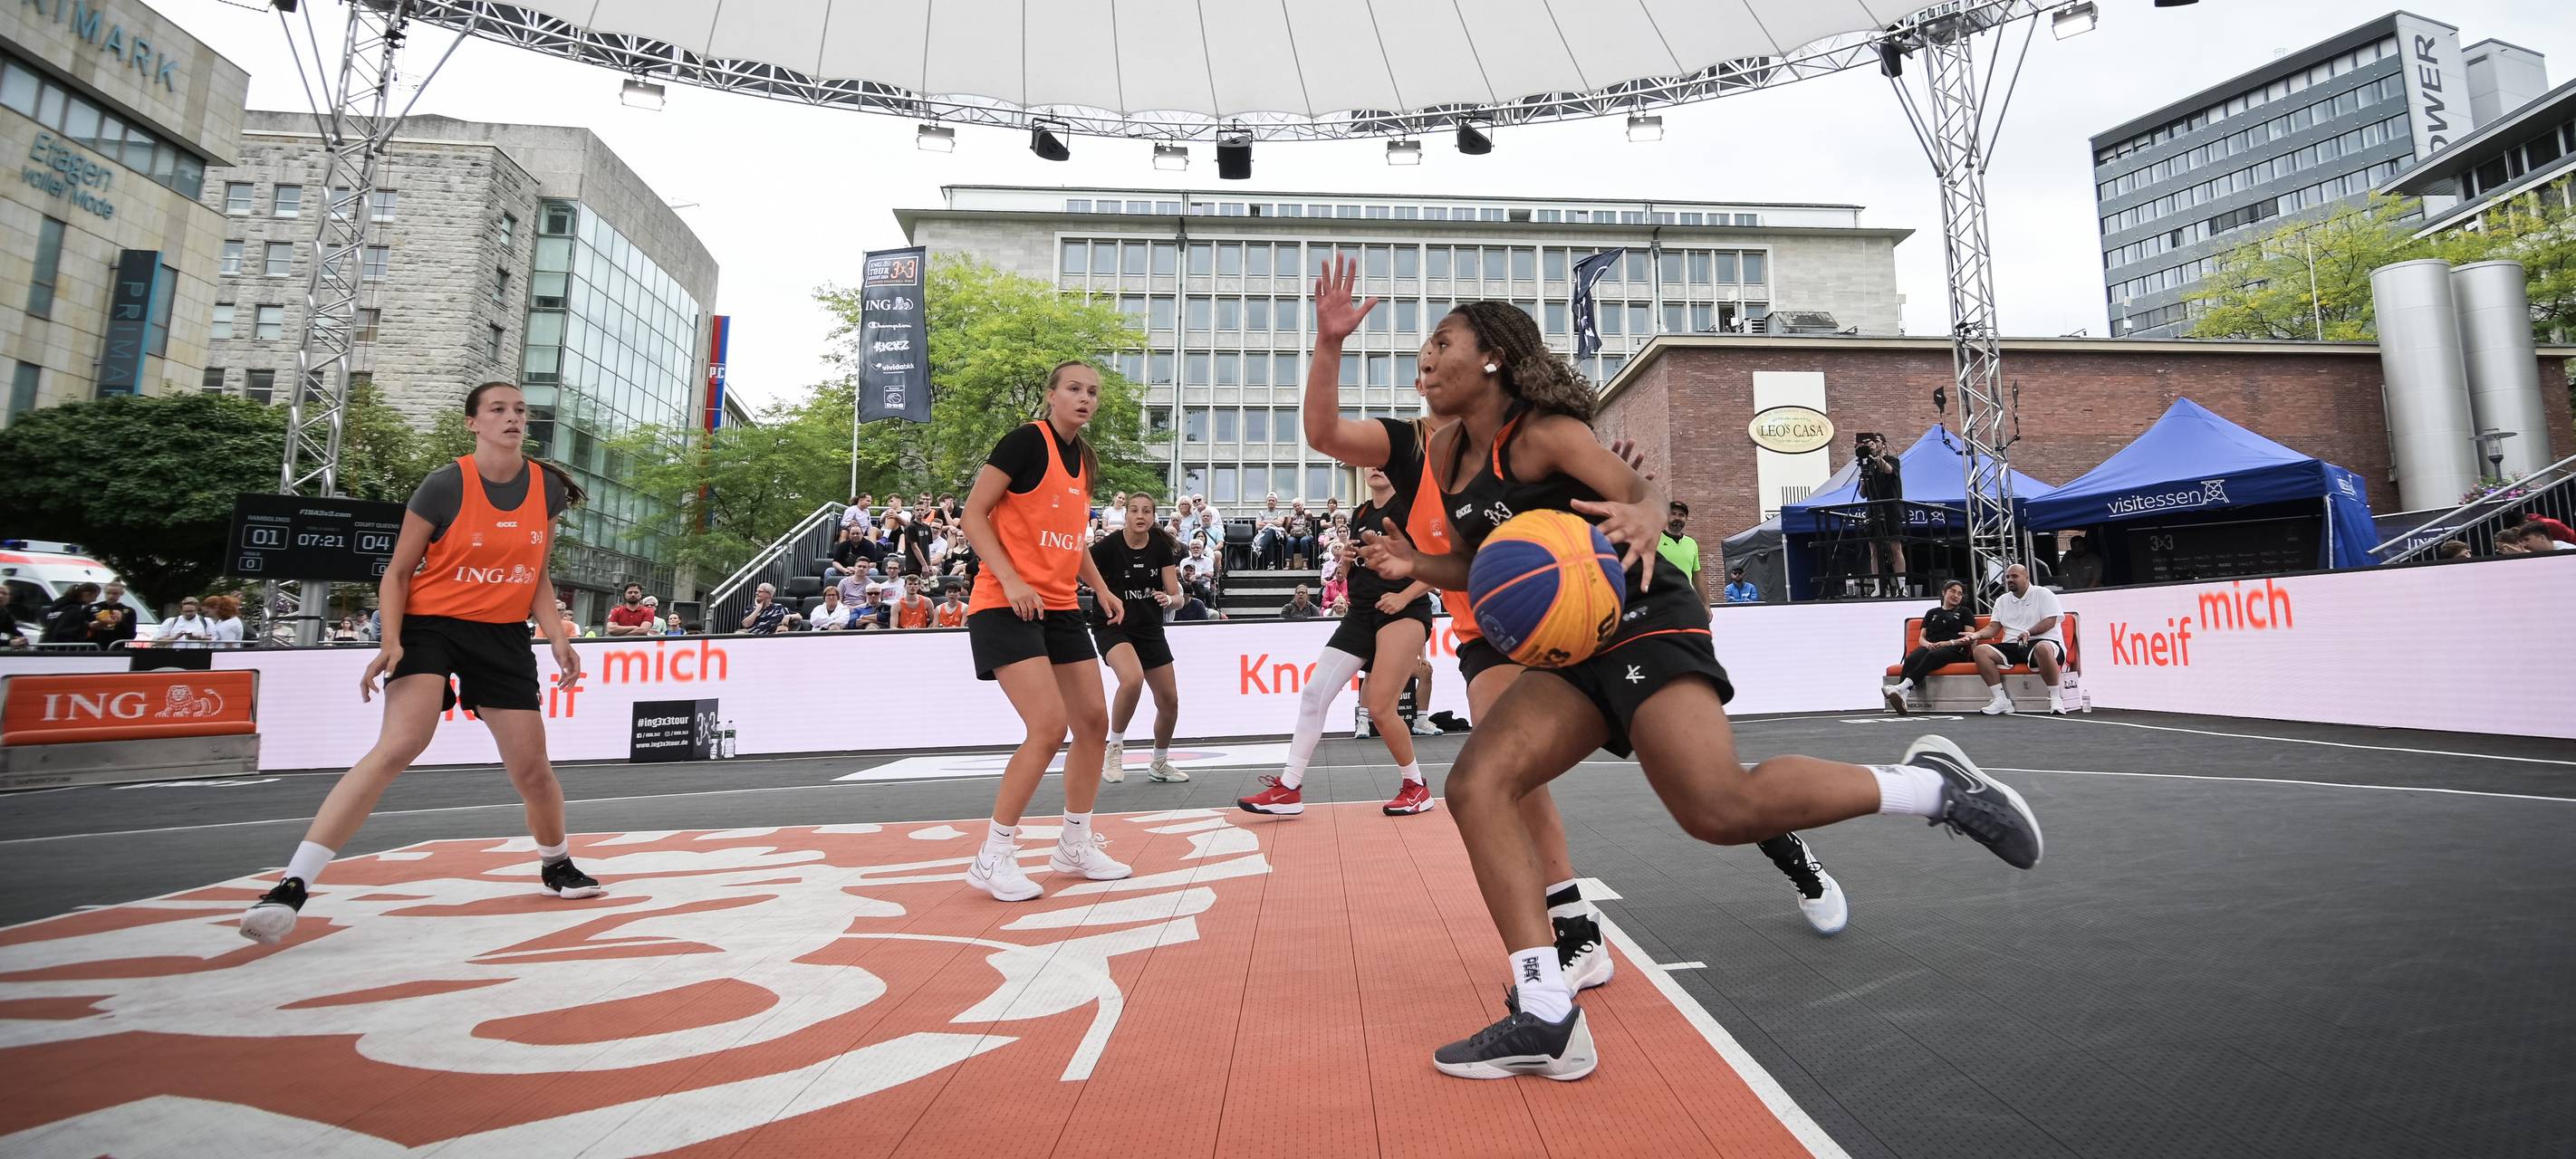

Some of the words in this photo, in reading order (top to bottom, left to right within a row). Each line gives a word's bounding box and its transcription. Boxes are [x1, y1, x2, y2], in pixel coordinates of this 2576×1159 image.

[29, 130, 113, 192] Etagen
[22, 165, 63, 198] voller
[69, 187, 115, 220] Mode
[865, 299, 891, 311] ING
[868, 321, 912, 330] Champion
[1793, 424, 1824, 437] CASA
[2107, 486, 2201, 515] visitessen
[252, 529, 279, 545] 01
[298, 532, 345, 548] 07:21
[362, 535, 389, 551] 04
[1039, 530, 1073, 551] ING
[454, 566, 505, 584] ING
[1124, 589, 1142, 600] ING
[2198, 579, 2292, 631] mich
[2110, 616, 2191, 666] Kneif
[602, 639, 727, 684] mich
[40, 692, 149, 722] ING
[638, 716, 688, 728] #ing3x3tour
[1522, 956, 1542, 983] PEAK
